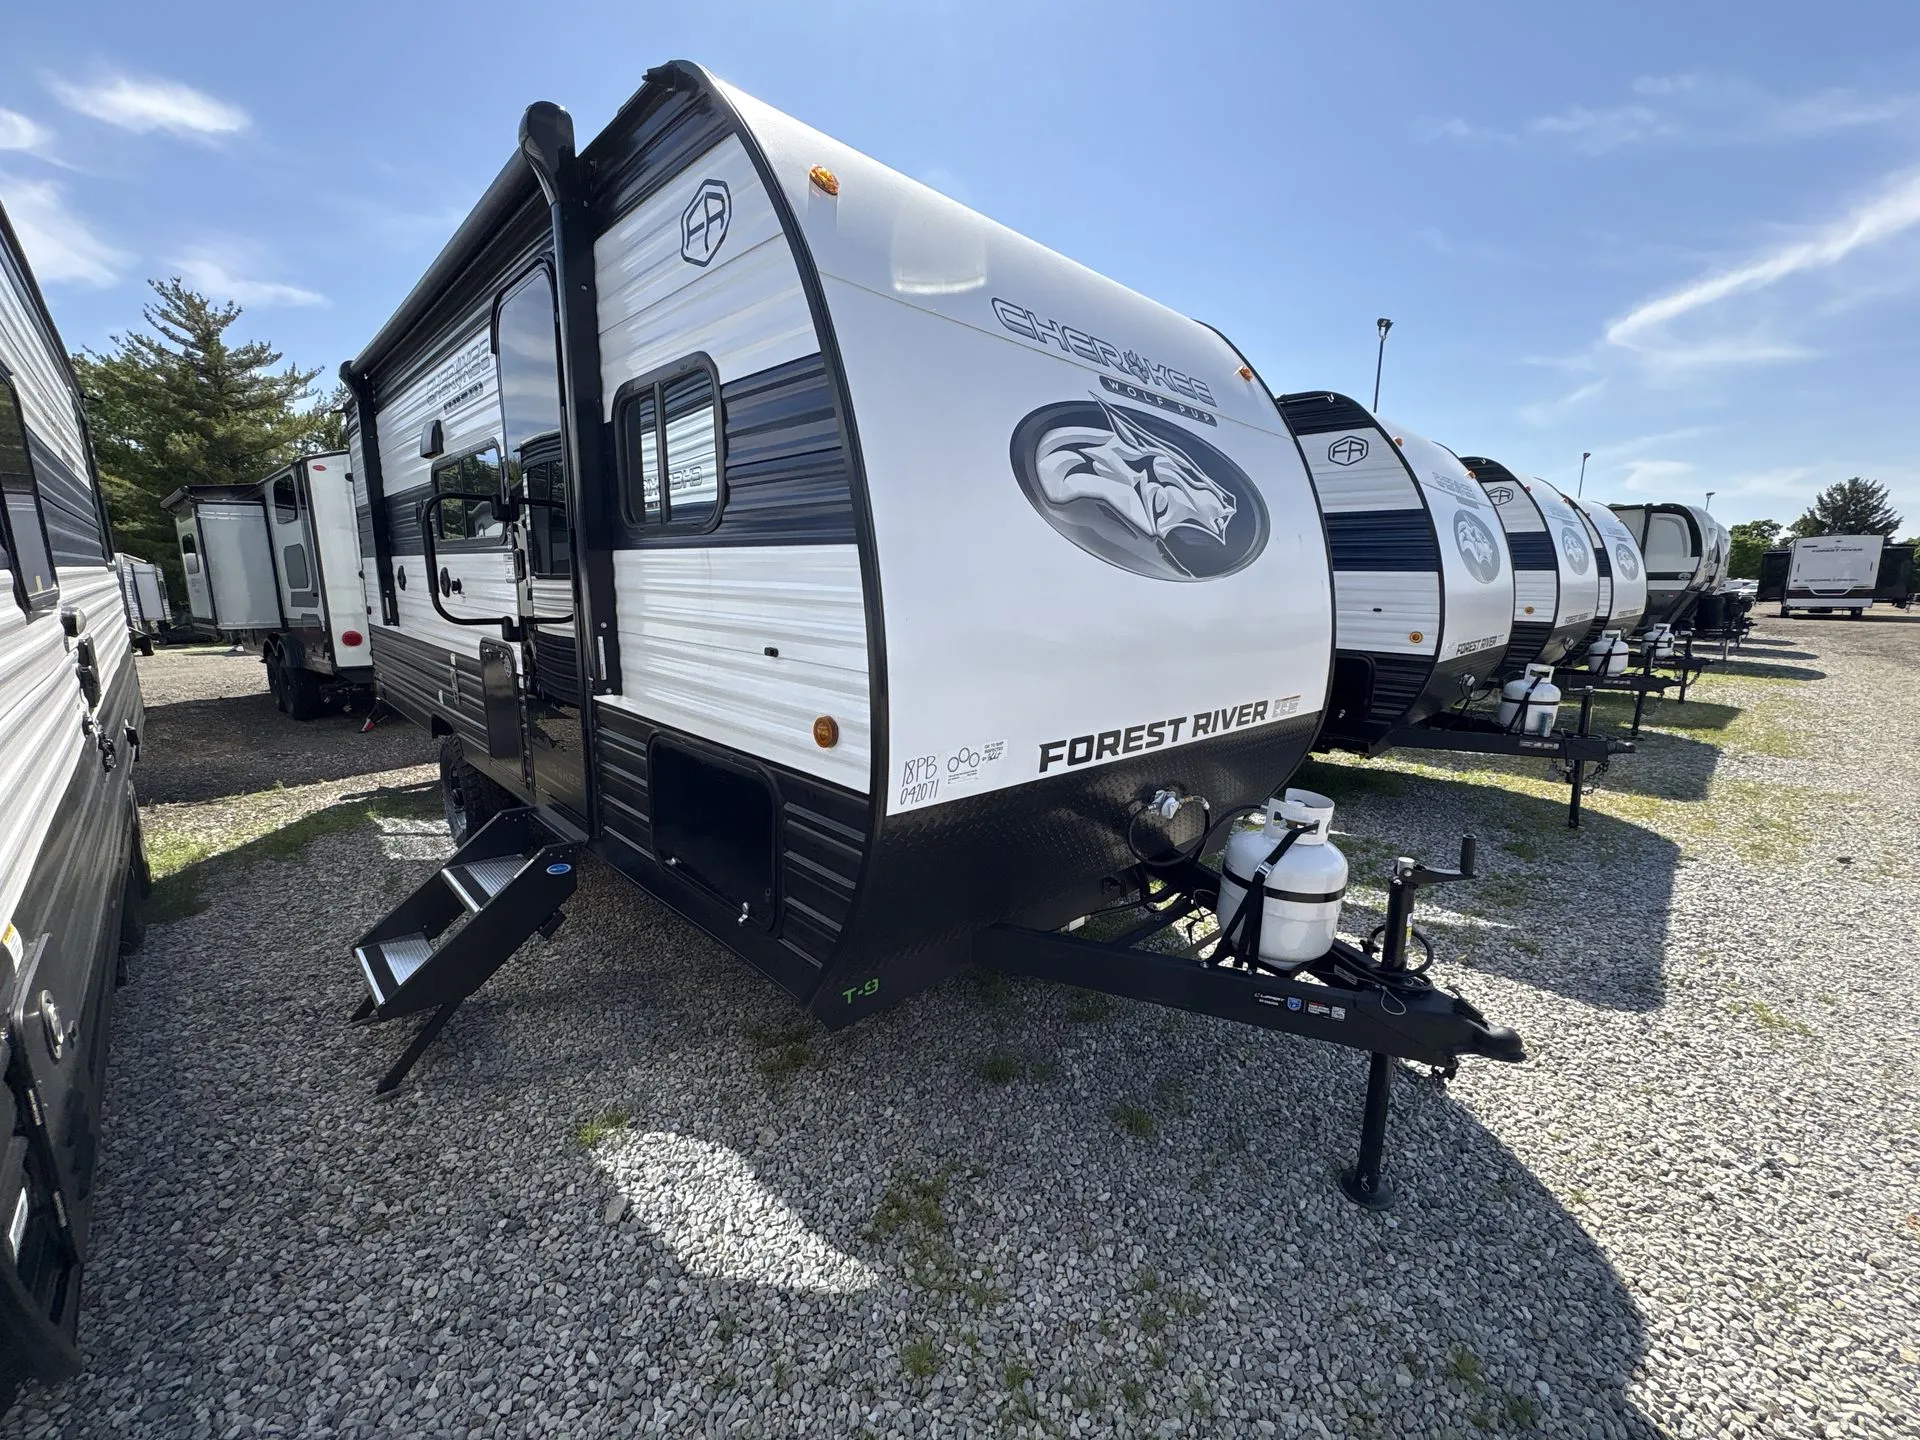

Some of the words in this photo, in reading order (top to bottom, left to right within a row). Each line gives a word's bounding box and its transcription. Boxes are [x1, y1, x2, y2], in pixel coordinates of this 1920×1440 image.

[686, 191, 726, 253] FR
[1108, 379, 1165, 406] WOLF
[1179, 404, 1213, 422] PUP
[1332, 440, 1365, 462] FR
[1456, 639, 1481, 655] FOREST
[1481, 635, 1498, 649] RIVER
[1038, 717, 1187, 773] FOREST
[1192, 700, 1269, 738] RIVER
[902, 755, 938, 787] 18PB
[900, 779, 939, 805] 042071
[842, 978, 879, 1004] T-9
